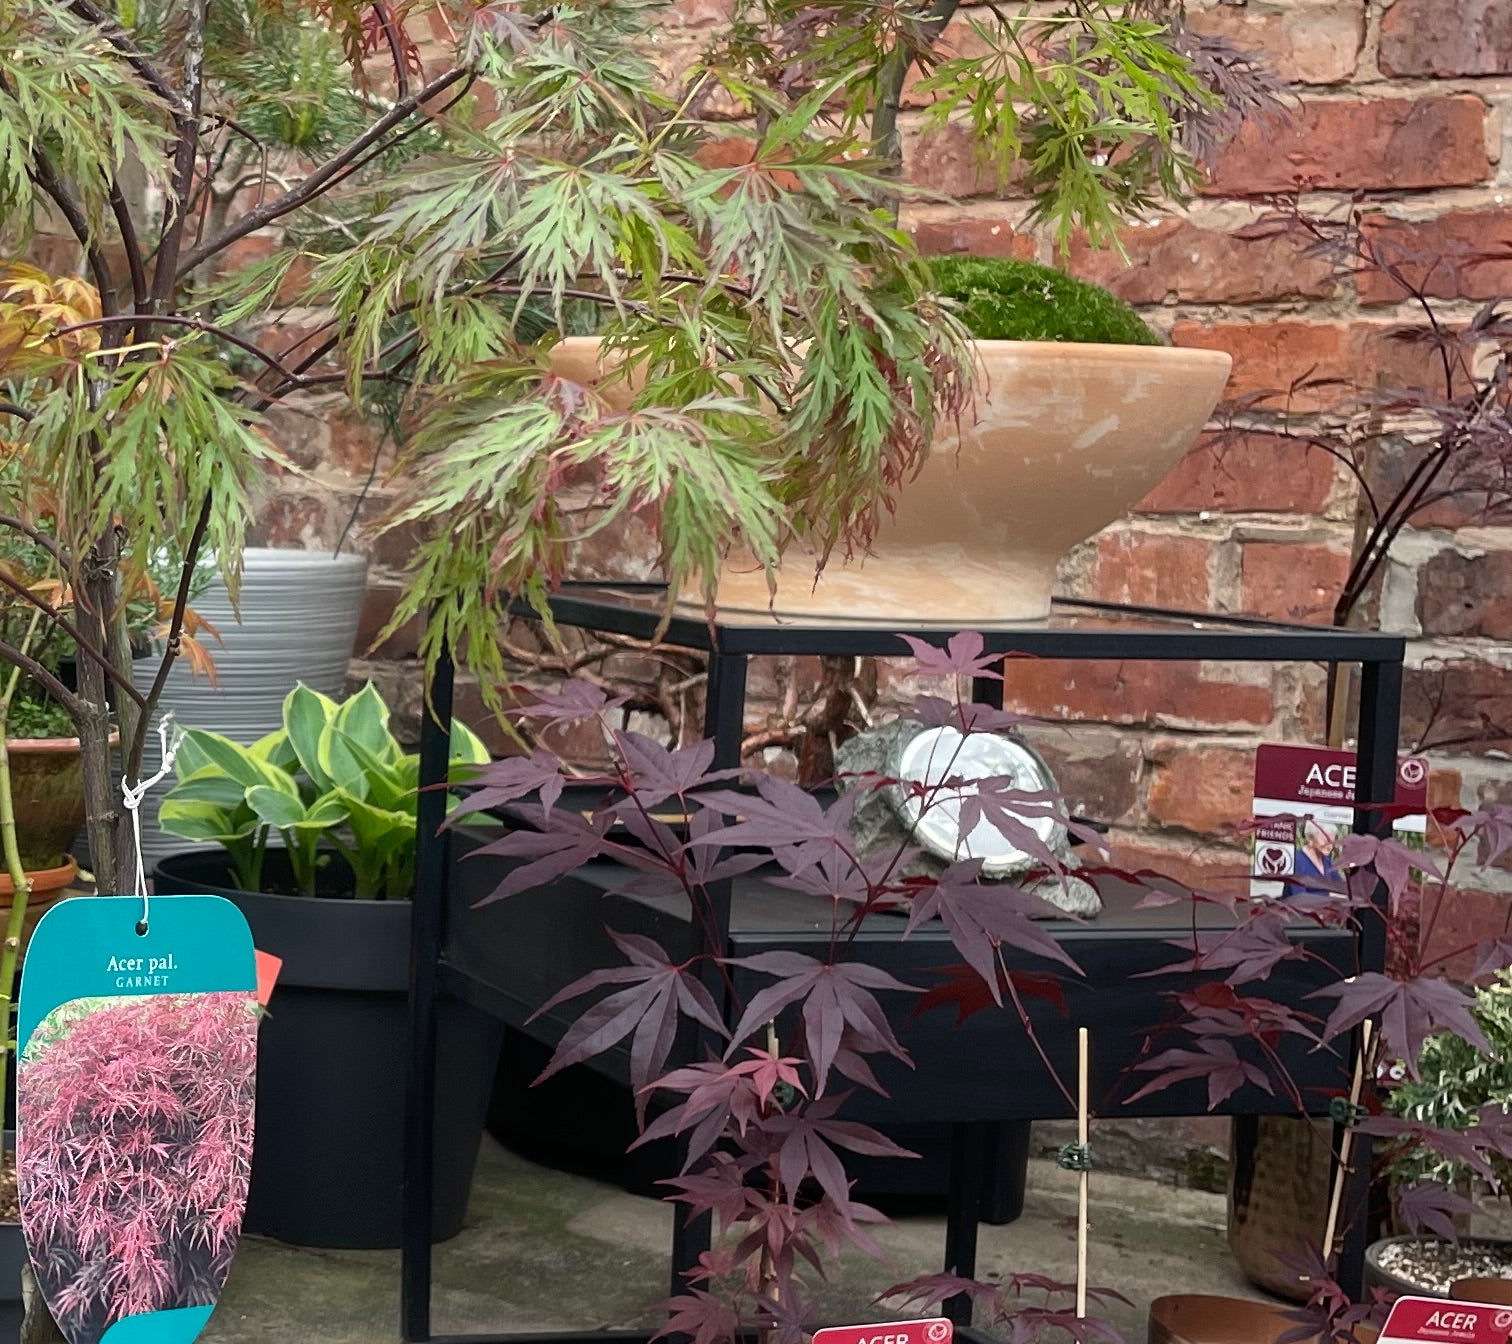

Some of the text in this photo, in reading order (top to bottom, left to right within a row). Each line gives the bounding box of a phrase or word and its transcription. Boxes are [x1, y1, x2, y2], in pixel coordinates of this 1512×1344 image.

[1305, 763, 1357, 788] ACE
[1298, 784, 1344, 799] Japanese
[106, 953, 178, 974] Acer pal.
[115, 975, 169, 988] GARNET
[1425, 1310, 1478, 1331] ACER
